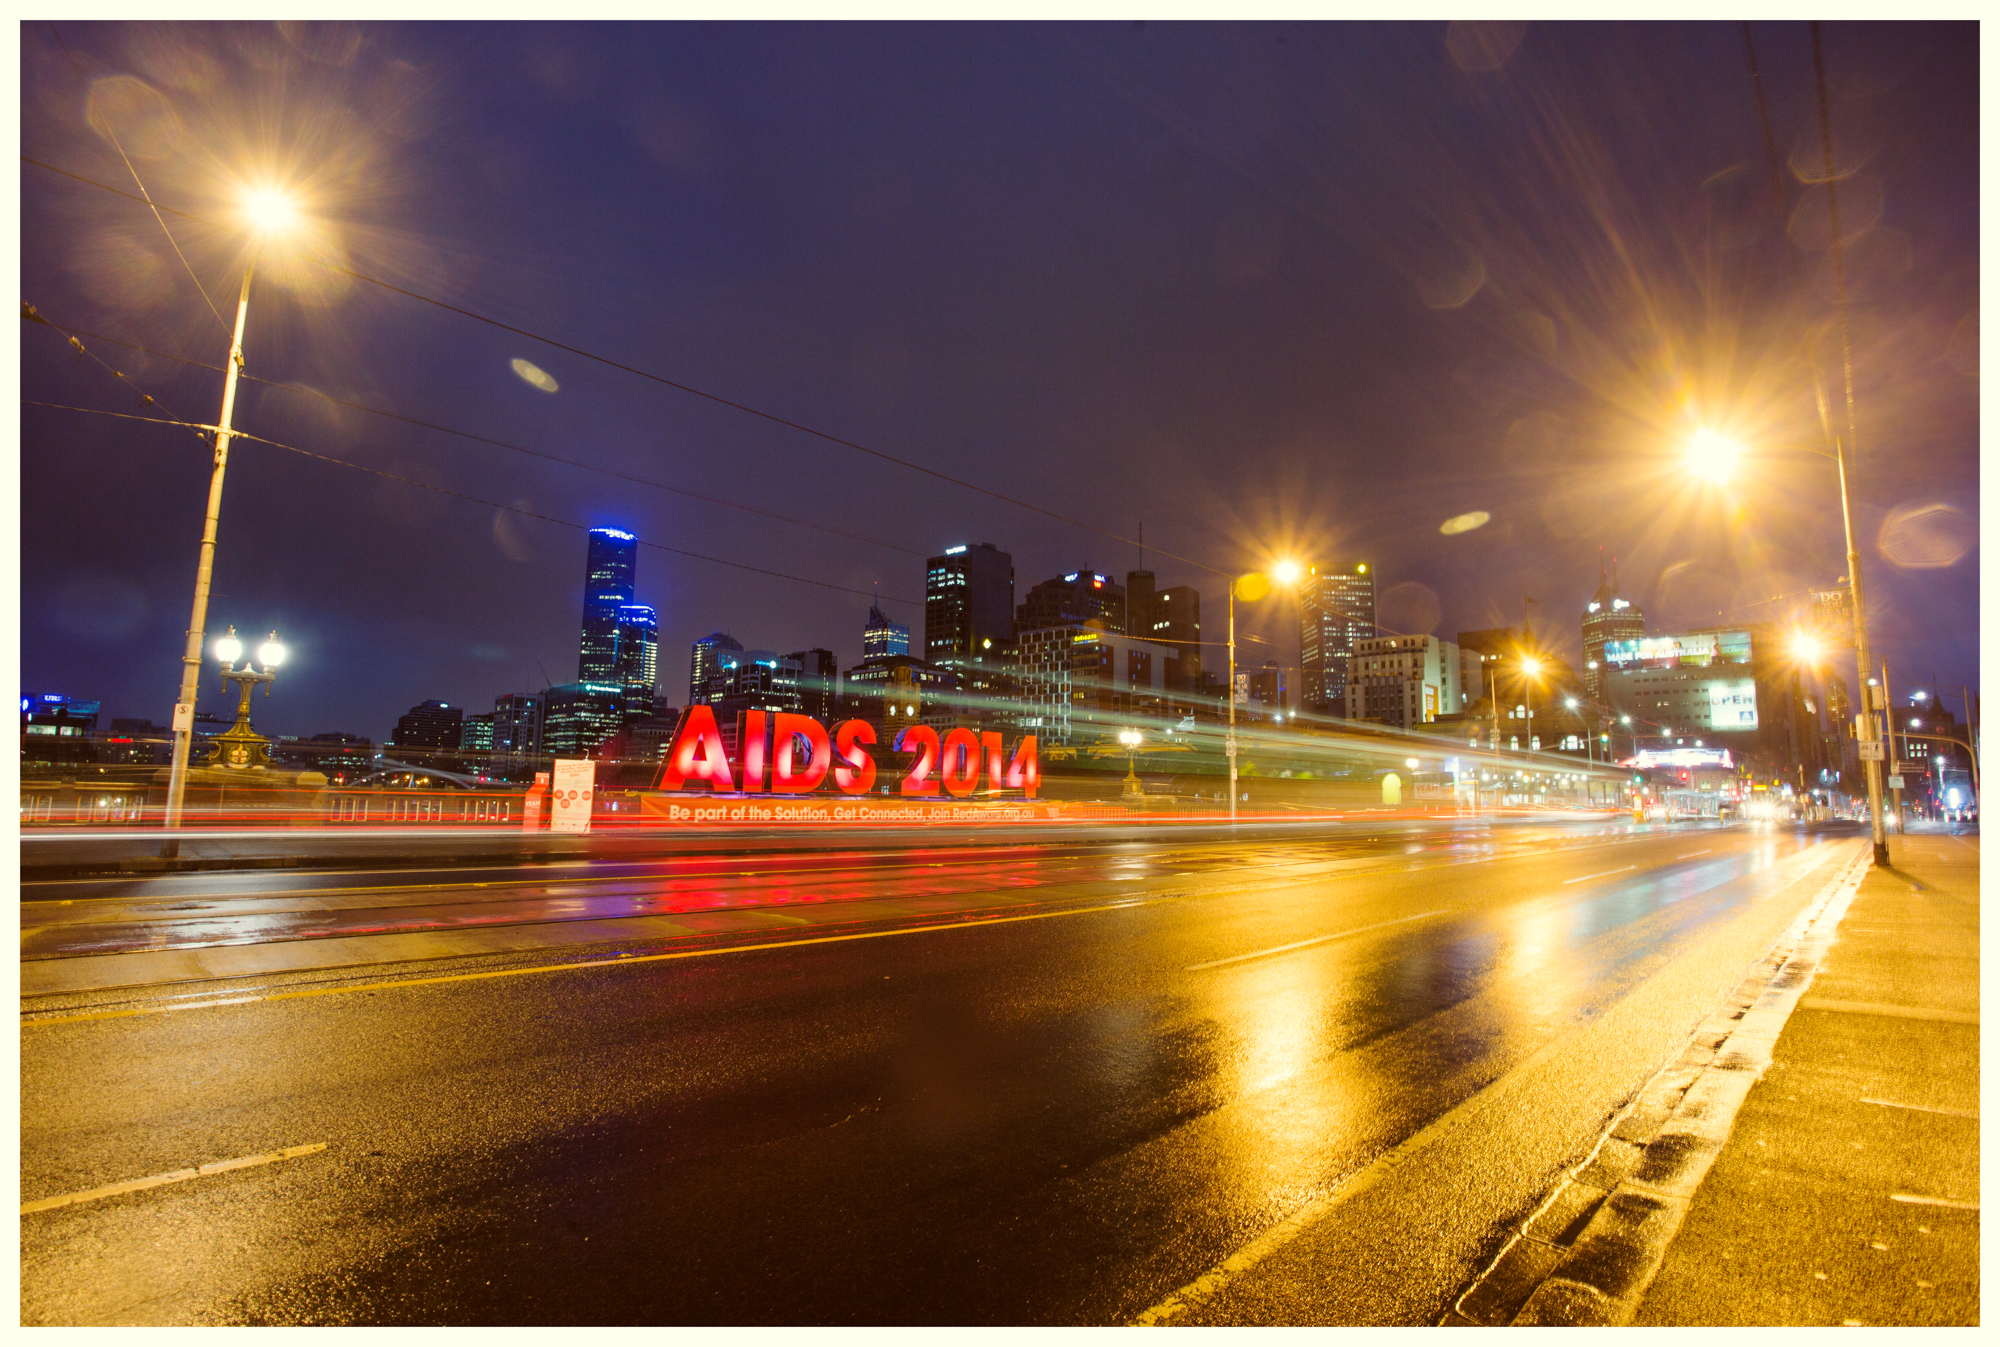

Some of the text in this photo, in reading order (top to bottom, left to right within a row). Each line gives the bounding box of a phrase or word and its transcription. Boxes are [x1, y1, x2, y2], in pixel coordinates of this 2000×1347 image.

[1820, 591, 1842, 602] DO
[1822, 601, 1842, 609] YOU
[1817, 608, 1849, 616] HEAR
[1606, 648, 1710, 661] MADE FOR AUSTRALIA
[44, 694, 63, 702] URS
[655, 704, 1042, 798] AIDS 2014
[1416, 783, 1439, 794] YEAH
[525, 799, 541, 808] YEAH
[669, 805, 1035, 823] Be part of the Solution, Get Connected, Join RedAware.org.au
